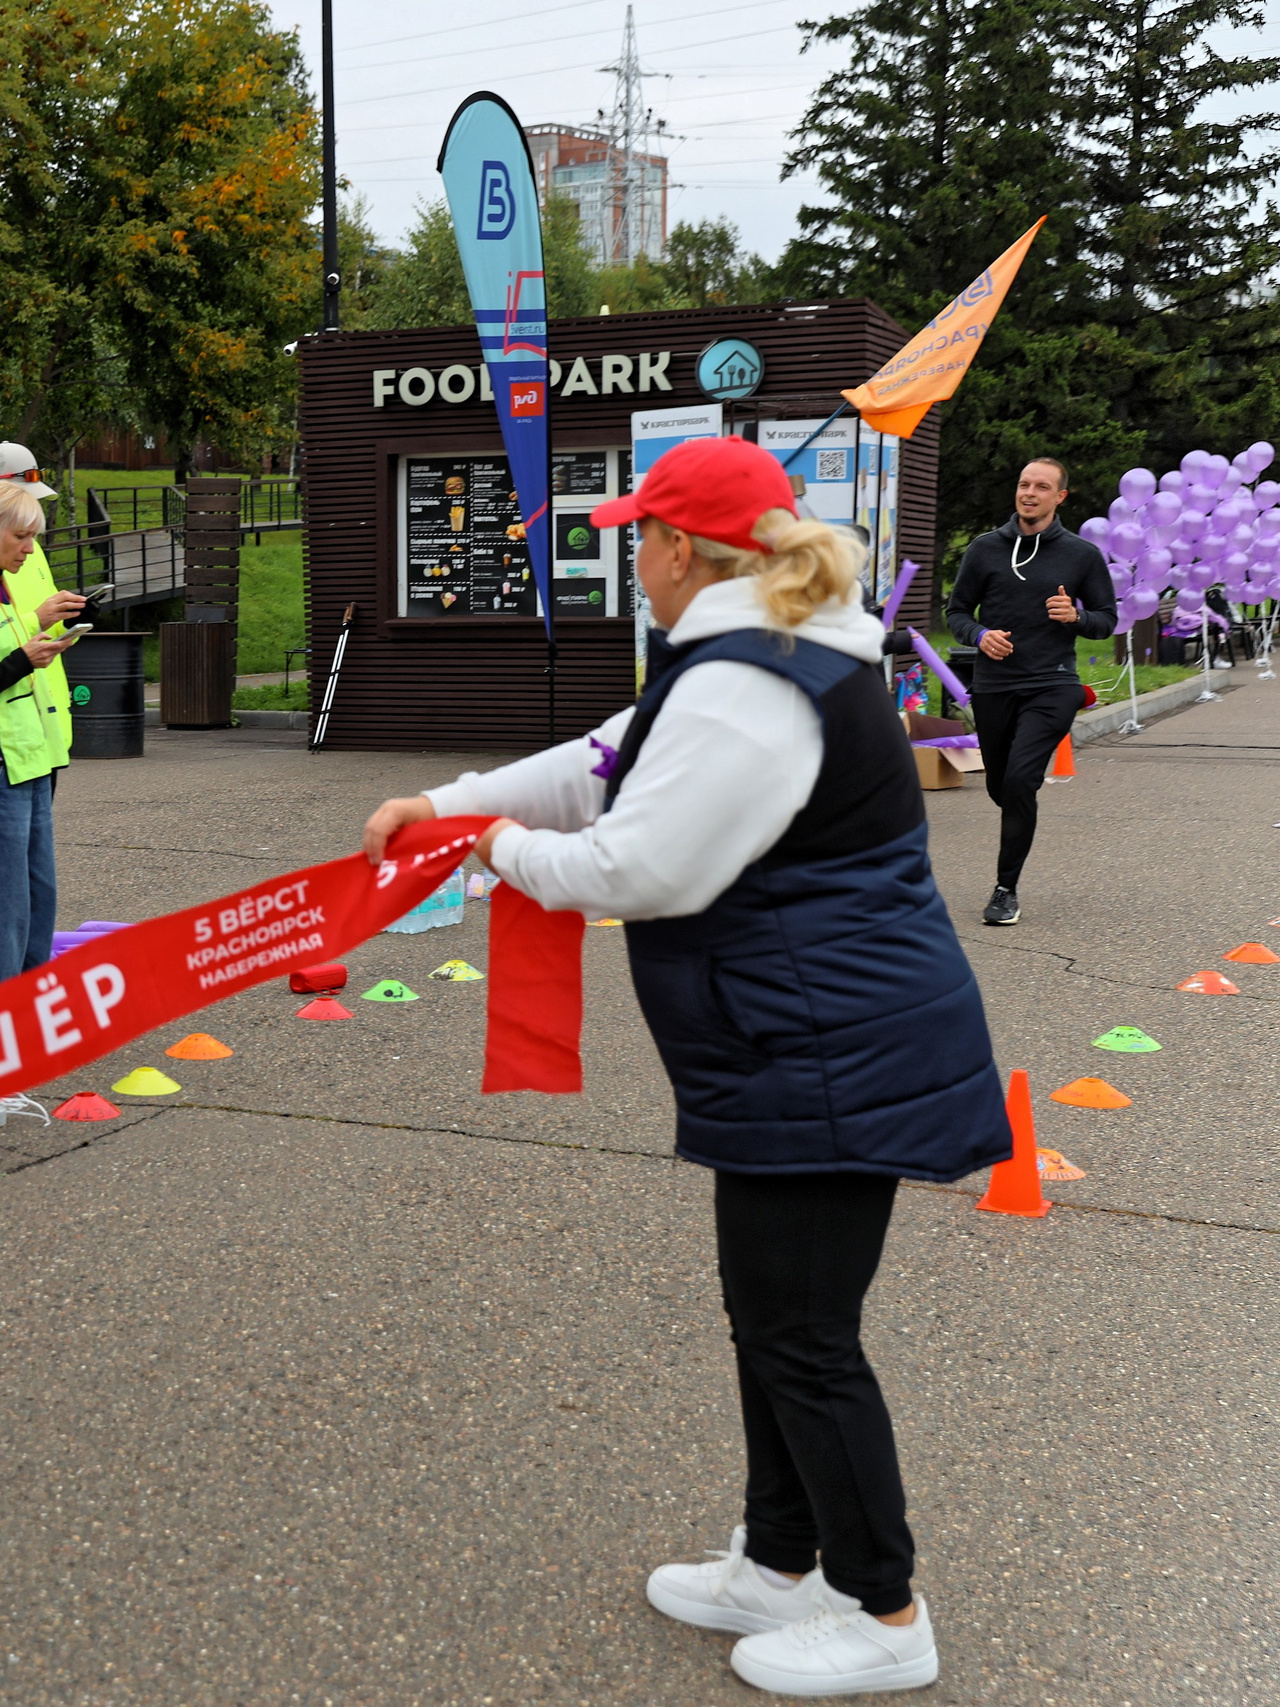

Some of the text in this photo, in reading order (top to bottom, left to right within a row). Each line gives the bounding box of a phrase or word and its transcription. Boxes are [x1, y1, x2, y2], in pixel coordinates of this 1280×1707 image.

[186, 905, 326, 971] КРАСНОЯРСК
[194, 879, 310, 944] 5 ВЁРСТ
[199, 932, 324, 990] НАБЕРЕЖНАЯ
